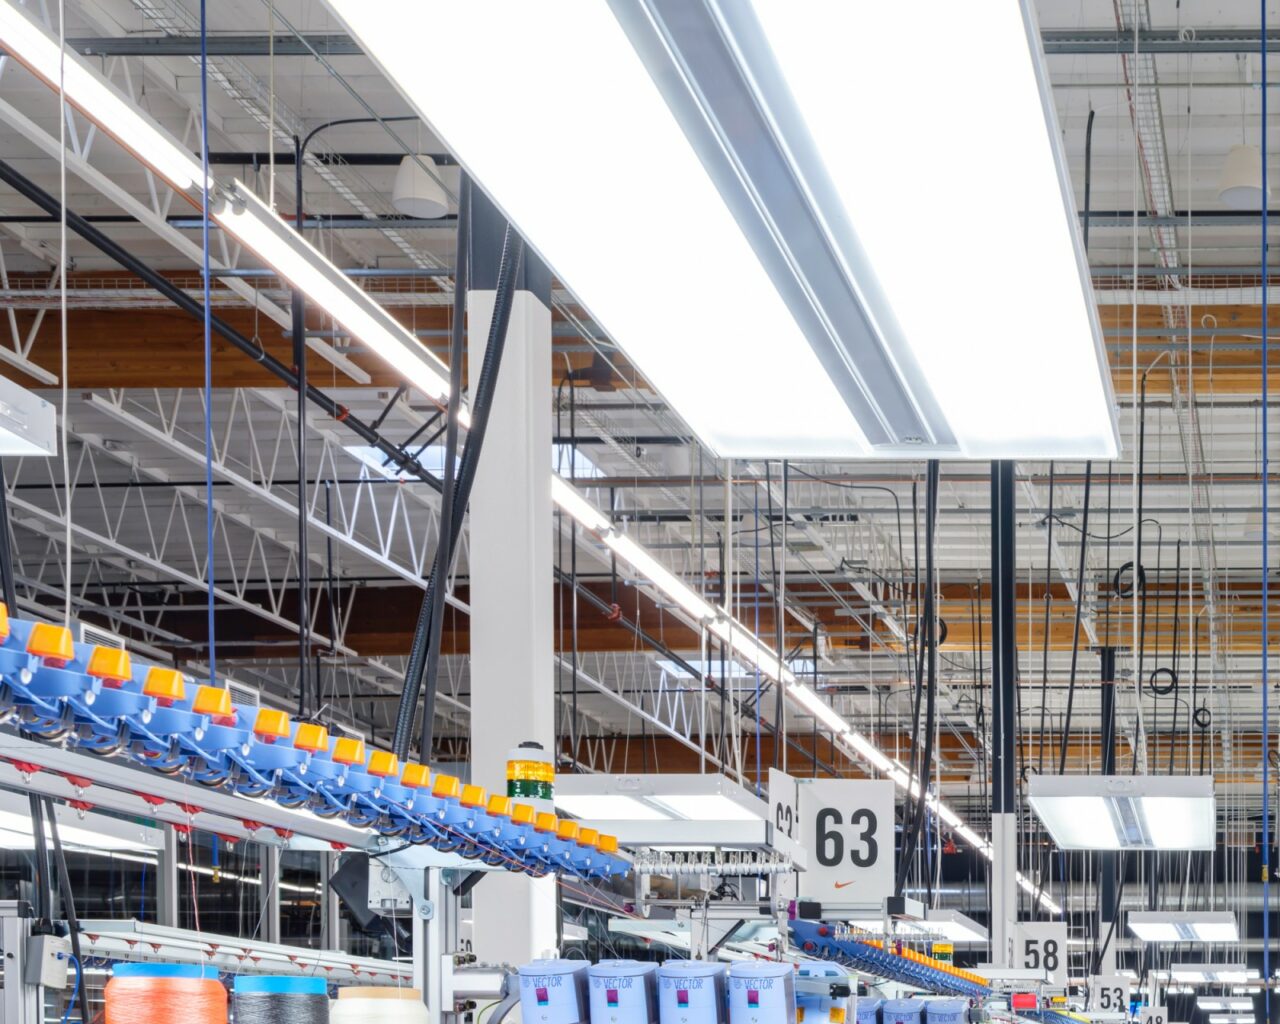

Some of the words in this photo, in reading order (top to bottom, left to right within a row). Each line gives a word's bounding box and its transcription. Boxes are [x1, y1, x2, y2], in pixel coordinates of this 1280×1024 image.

[815, 807, 879, 868] 63
[1024, 939, 1059, 972] 58
[533, 976, 562, 988] VECTOR
[603, 978, 633, 989] VECTOR
[674, 979, 703, 990] VECTOR
[744, 979, 774, 990] VECTOR
[1100, 987, 1124, 1010] 53
